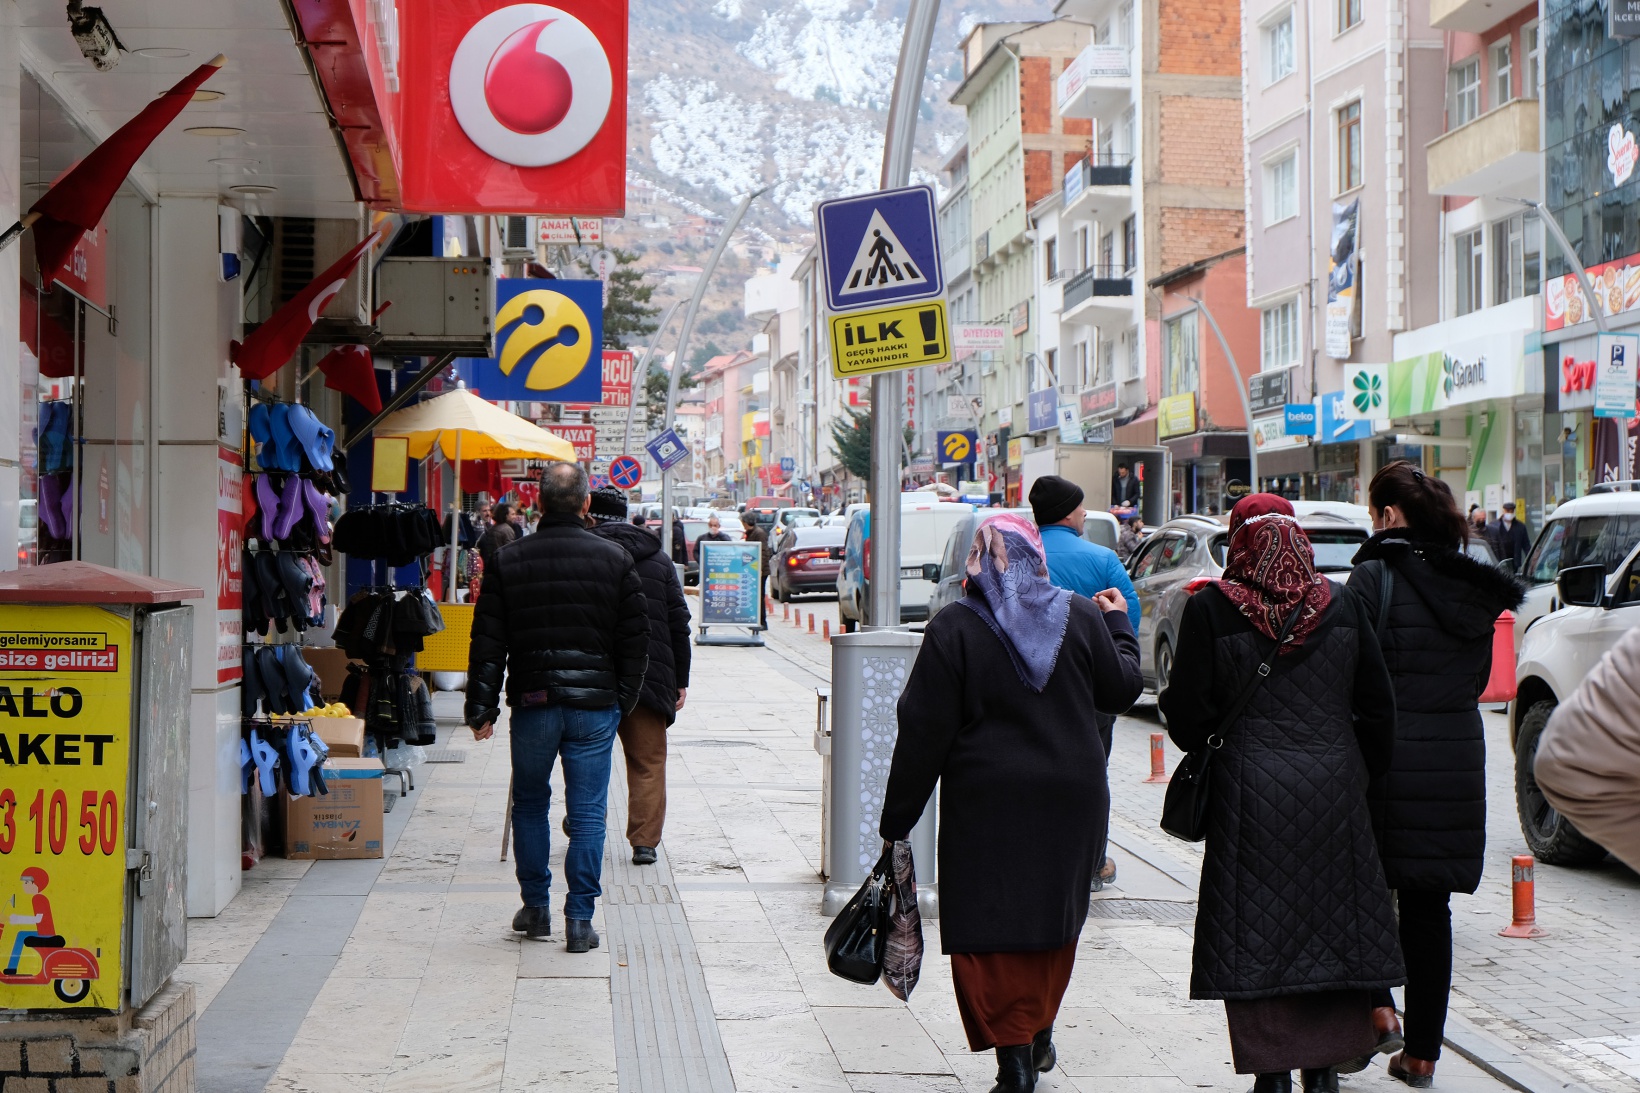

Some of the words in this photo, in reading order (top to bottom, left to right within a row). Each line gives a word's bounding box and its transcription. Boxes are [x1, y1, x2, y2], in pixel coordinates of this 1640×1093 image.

[541, 221, 599, 230] ANAHARCI
[845, 319, 905, 346] İLK
[846, 347, 875, 358] GEÇİŞ
[877, 343, 908, 353] HAKKI
[847, 352, 909, 367] YAYANINDIR
[1288, 411, 1314, 422] beko
[0, 634, 98, 648] gelemiyorsanız
[0, 651, 38, 667] size
[44, 651, 115, 670] geliriz!
[29, 788, 68, 856] 10
[79, 789, 118, 856] 50
